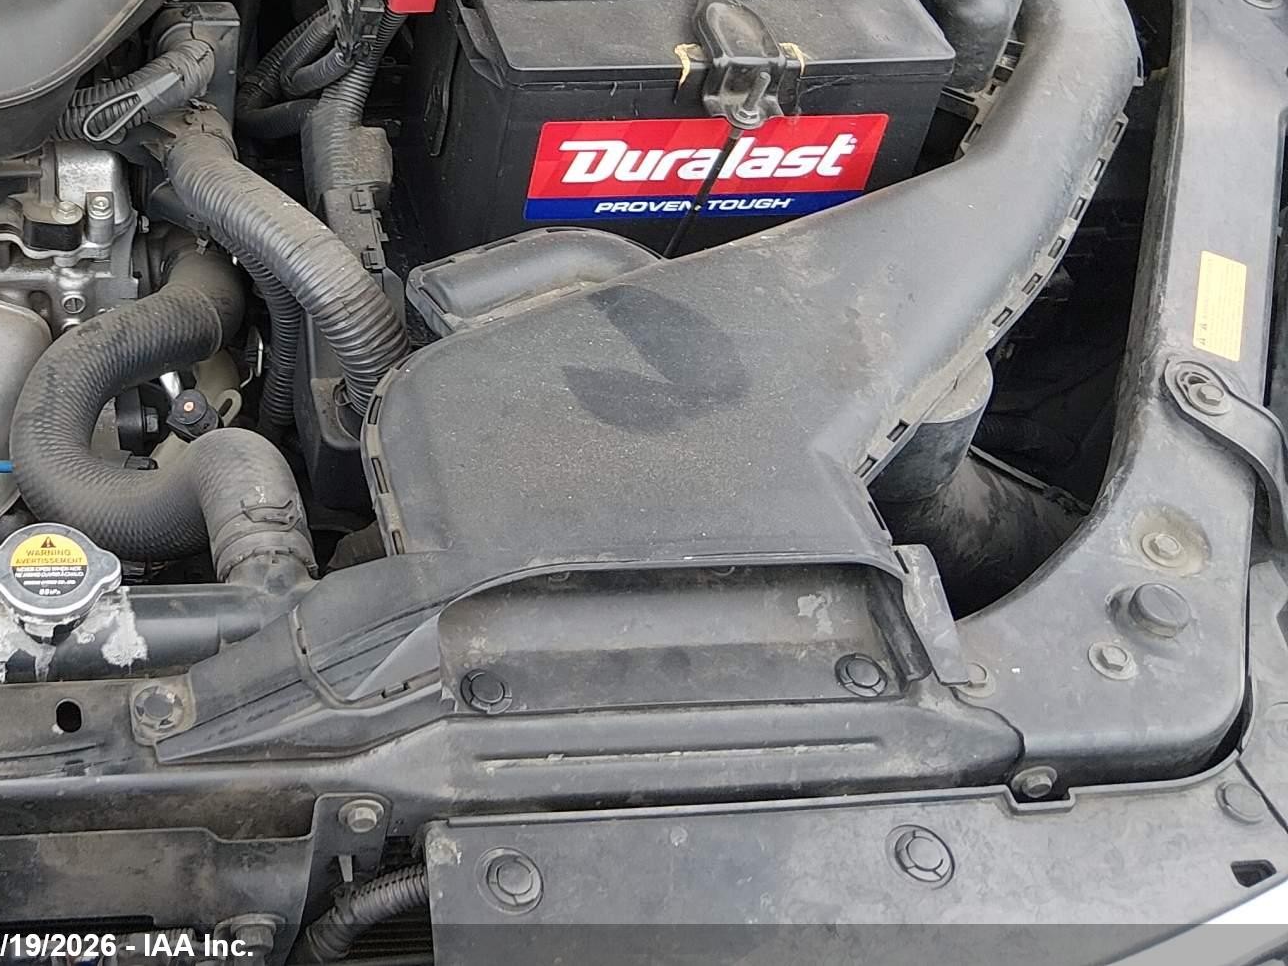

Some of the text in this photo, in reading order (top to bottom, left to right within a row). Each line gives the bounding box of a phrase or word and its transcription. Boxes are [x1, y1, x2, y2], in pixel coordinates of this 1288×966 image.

[559, 134, 856, 183] Duralast
[594, 198, 790, 213] PROVEN TOUGH
